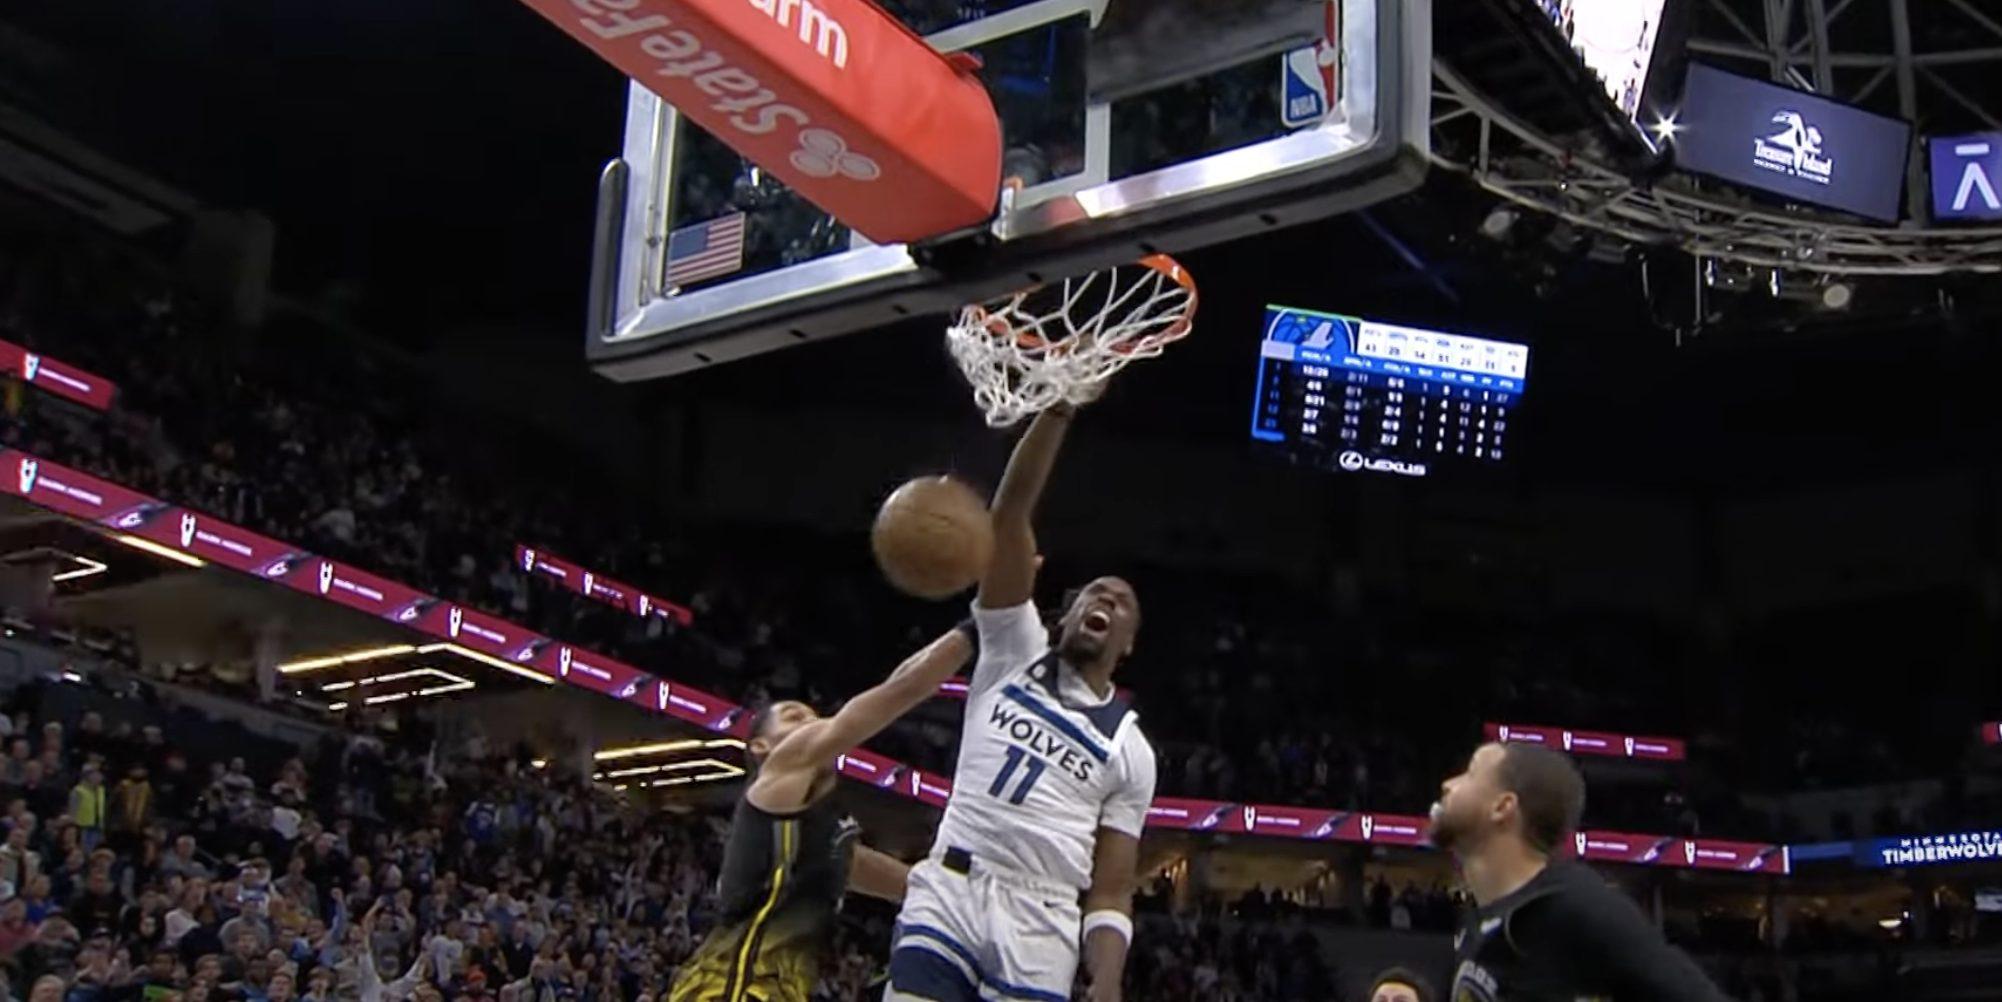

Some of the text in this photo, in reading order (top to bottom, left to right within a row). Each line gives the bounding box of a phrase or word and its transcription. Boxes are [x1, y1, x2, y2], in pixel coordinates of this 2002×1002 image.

[1289, 92, 1319, 119] NBA
[1364, 457, 1426, 476] LEXUS
[989, 704, 1093, 781] WOLVES
[988, 744, 1047, 805] 11
